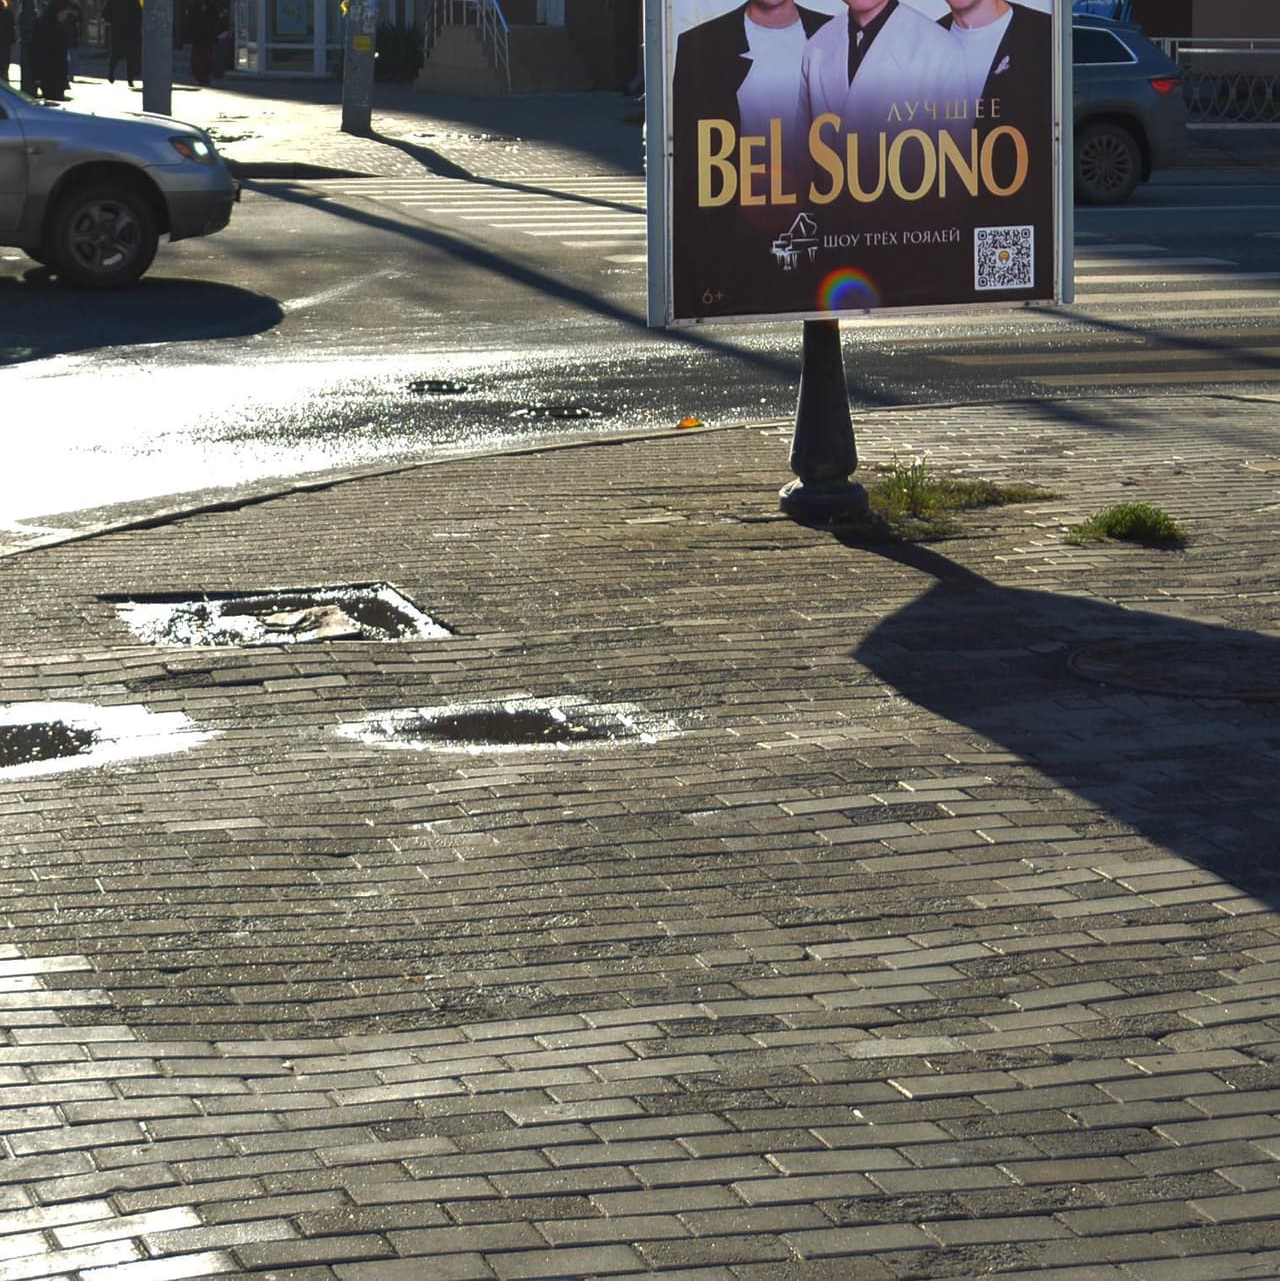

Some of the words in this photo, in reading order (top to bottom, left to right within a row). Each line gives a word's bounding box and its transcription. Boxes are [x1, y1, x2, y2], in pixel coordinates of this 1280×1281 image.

[887, 98, 1001, 122] ЛУЧШЕЕ
[823, 233, 860, 249] ШОУ
[864, 231, 898, 247] ТРЁХ
[903, 227, 961, 245] РОЯЛЕЙ
[701, 287, 725, 305] 6+
